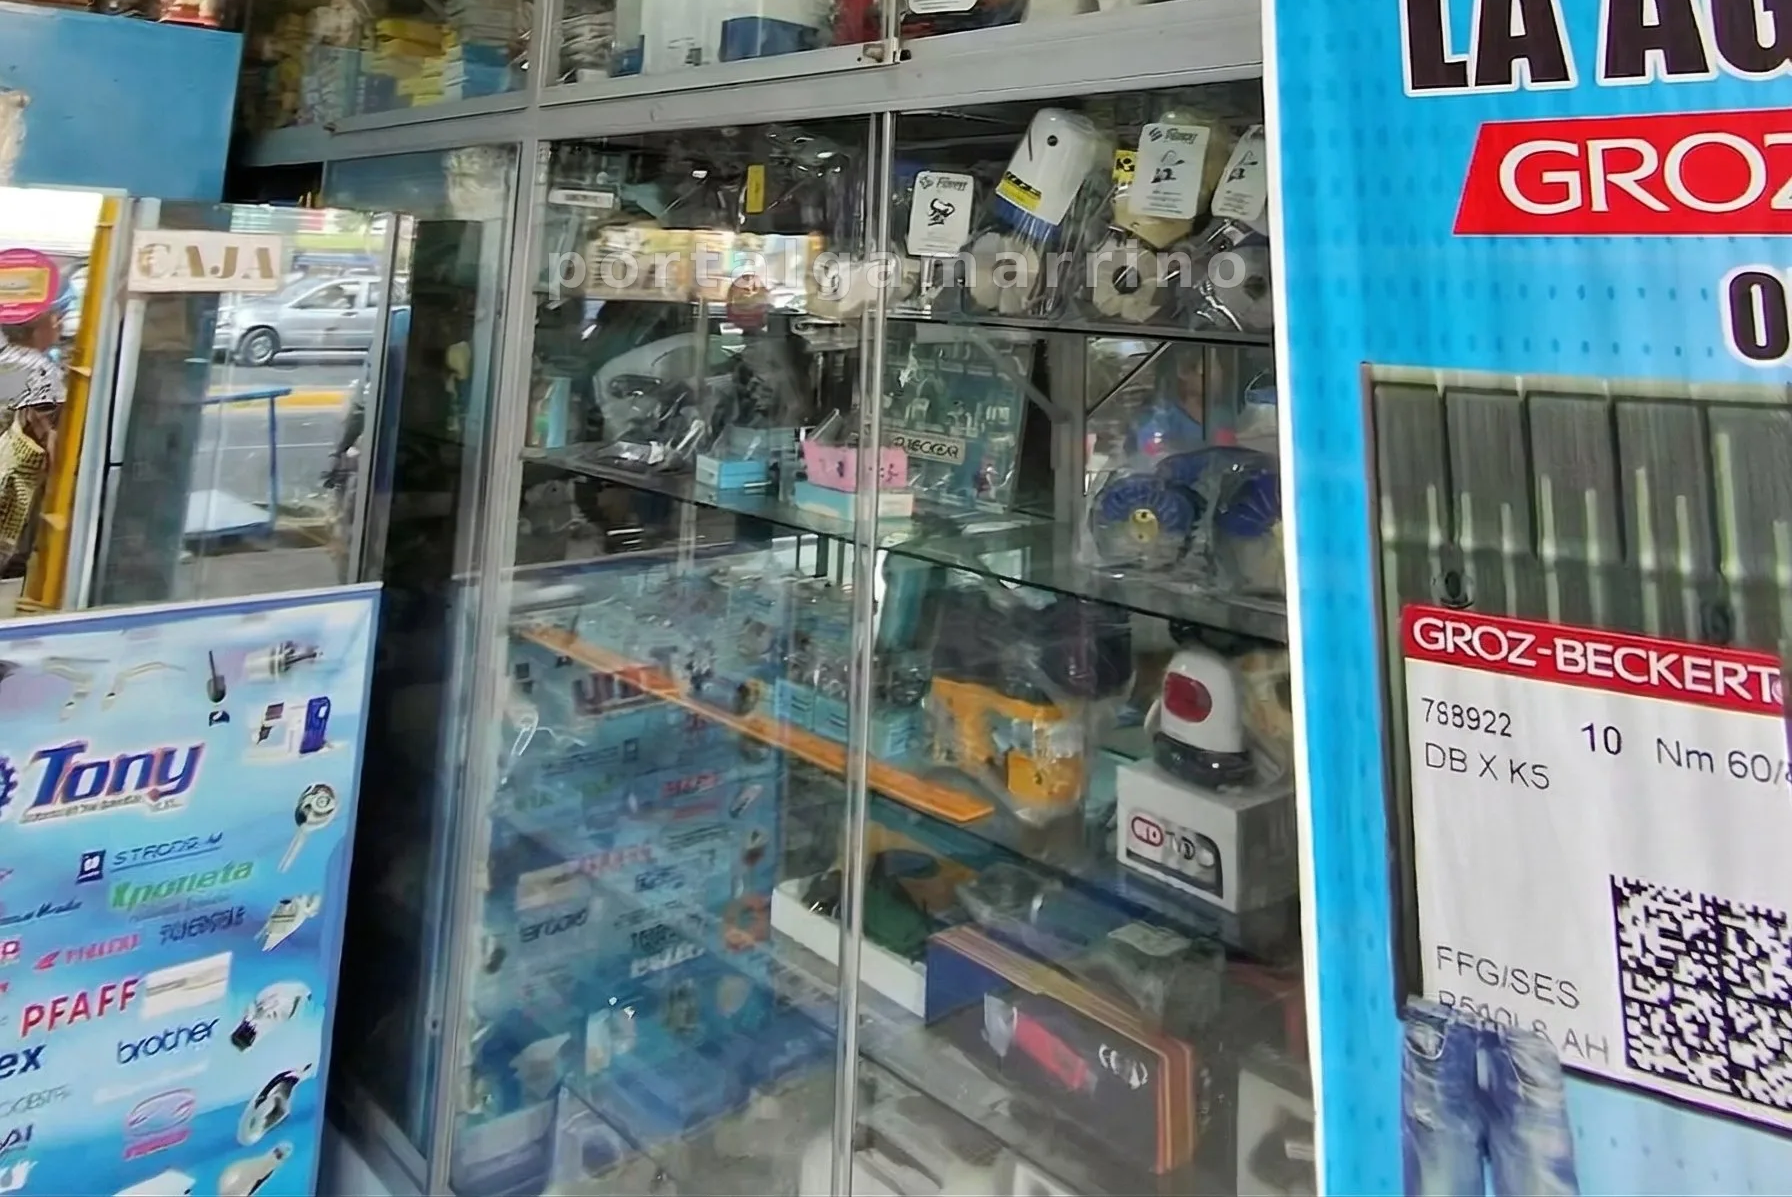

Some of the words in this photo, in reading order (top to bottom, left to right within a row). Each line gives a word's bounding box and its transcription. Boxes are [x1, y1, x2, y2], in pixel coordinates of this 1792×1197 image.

[136, 243, 274, 280] CAJA
[1411, 615, 1782, 705] GROZ-BECKERT
[1421, 697, 1512, 738] 788922
[1581, 722, 1622, 756] 10
[1655, 737, 1715, 773] Nm
[1425, 741, 1468, 773] DB
[1478, 751, 1499, 781] X
[30, 740, 204, 806] Tony
[21, 977, 140, 1038] PFAFF
[116, 1018, 220, 1065] brother
[1562, 1027, 1610, 1066] AH
